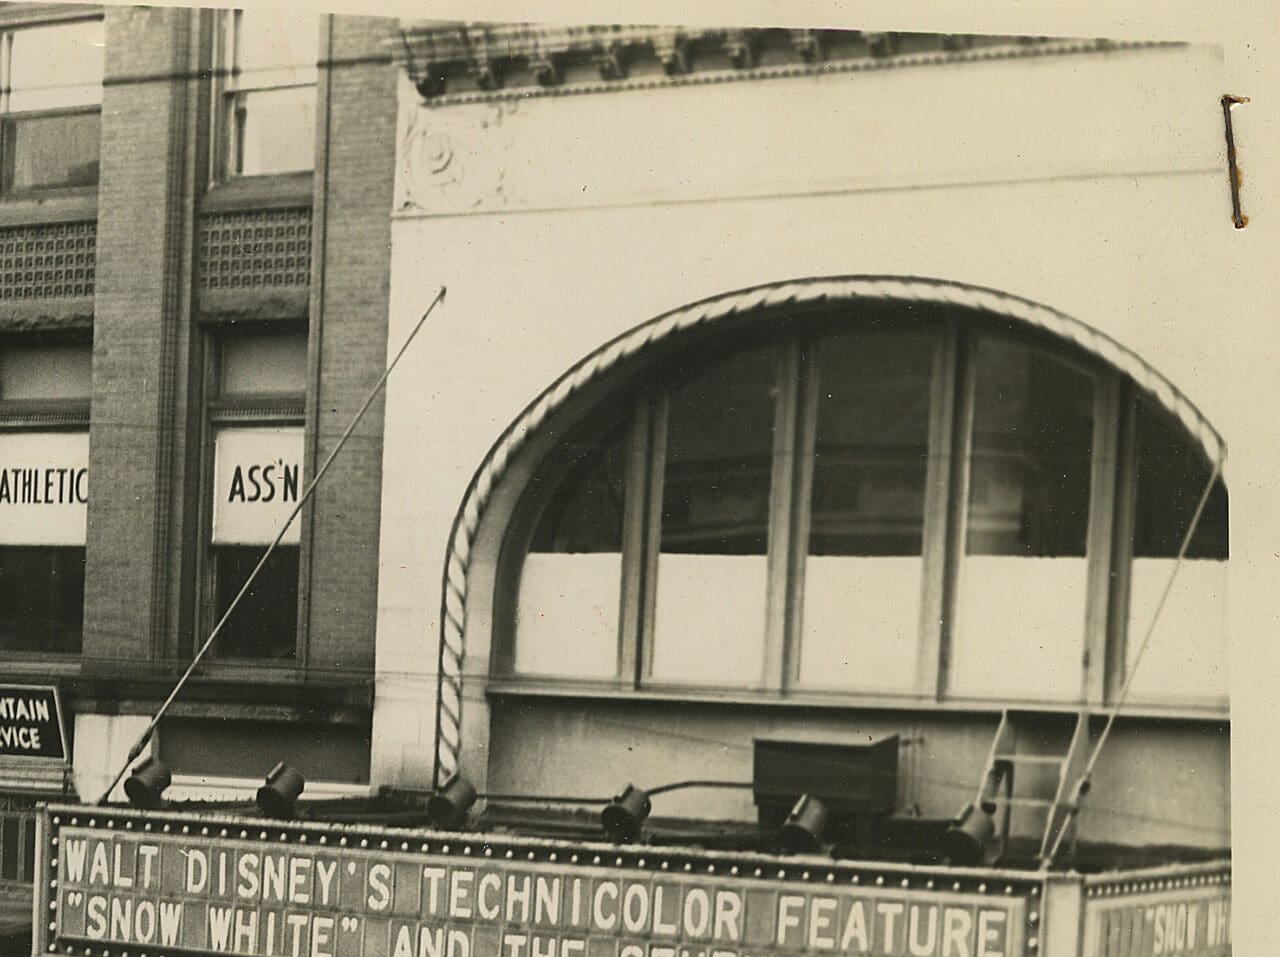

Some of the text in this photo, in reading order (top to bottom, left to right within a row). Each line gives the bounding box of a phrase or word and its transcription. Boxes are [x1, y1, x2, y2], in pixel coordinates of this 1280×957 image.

[228, 458, 299, 502] ASS'N
[66, 839, 159, 889] WALT
[186, 849, 392, 911] DISNEY'S
[423, 867, 742, 941] TECHNICOLOR
[67, 891, 182, 947] "SNOW
